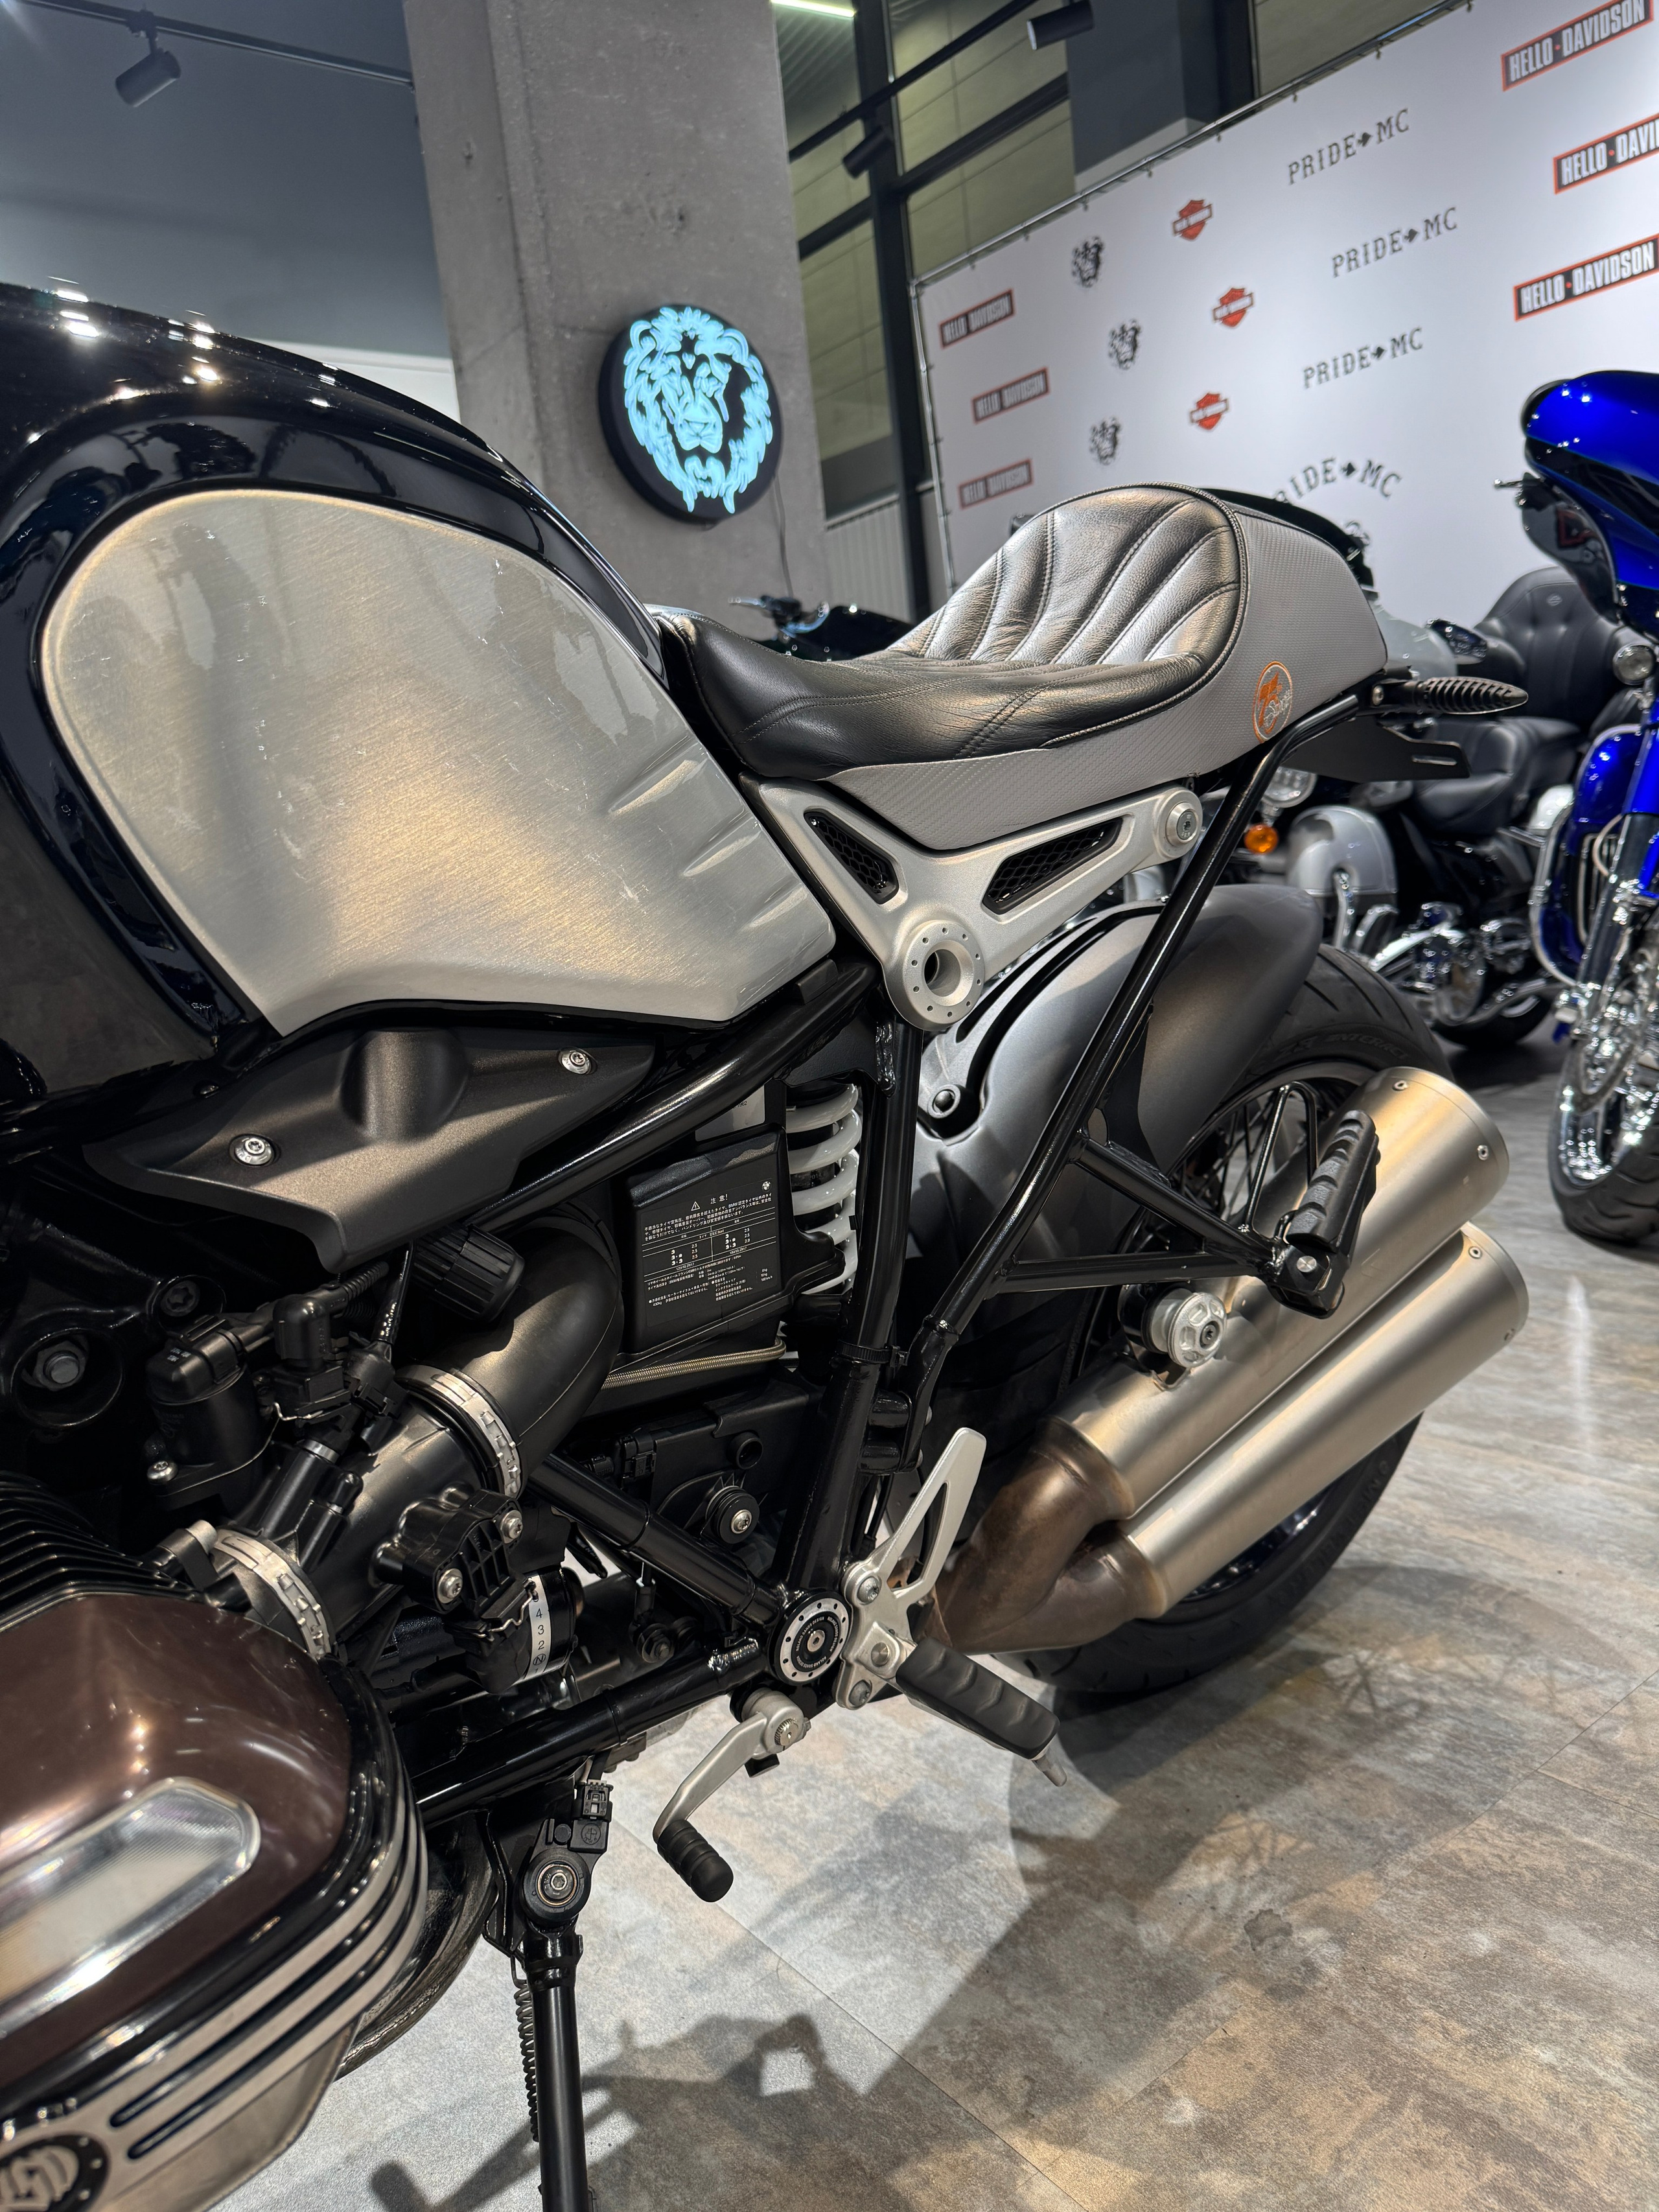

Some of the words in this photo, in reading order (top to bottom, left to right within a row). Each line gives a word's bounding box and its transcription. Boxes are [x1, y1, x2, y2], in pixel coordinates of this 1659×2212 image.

[1509, 38, 1553, 82] HELLO
[1562, 0, 1645, 57] DAVIDSON
[1288, 132, 1357, 185] PRIDE
[1376, 108, 1410, 145] MC
[1560, 141, 1608, 186] HELLO
[1332, 229, 1403, 279] PRIDE
[1423, 207, 1457, 241] MC
[1520, 274, 1565, 314] HELLO
[1572, 241, 1655, 296] DAVIDSON
[1303, 345, 1371, 390] PRIDE
[1390, 326, 1423, 359] MC
[1359, 459, 1403, 501] MC
[536, 1608, 543, 1619] 4
[537, 1624, 544, 1635] 3
[535, 1655, 544, 1664] N
[537, 1640, 544, 1650] 2
